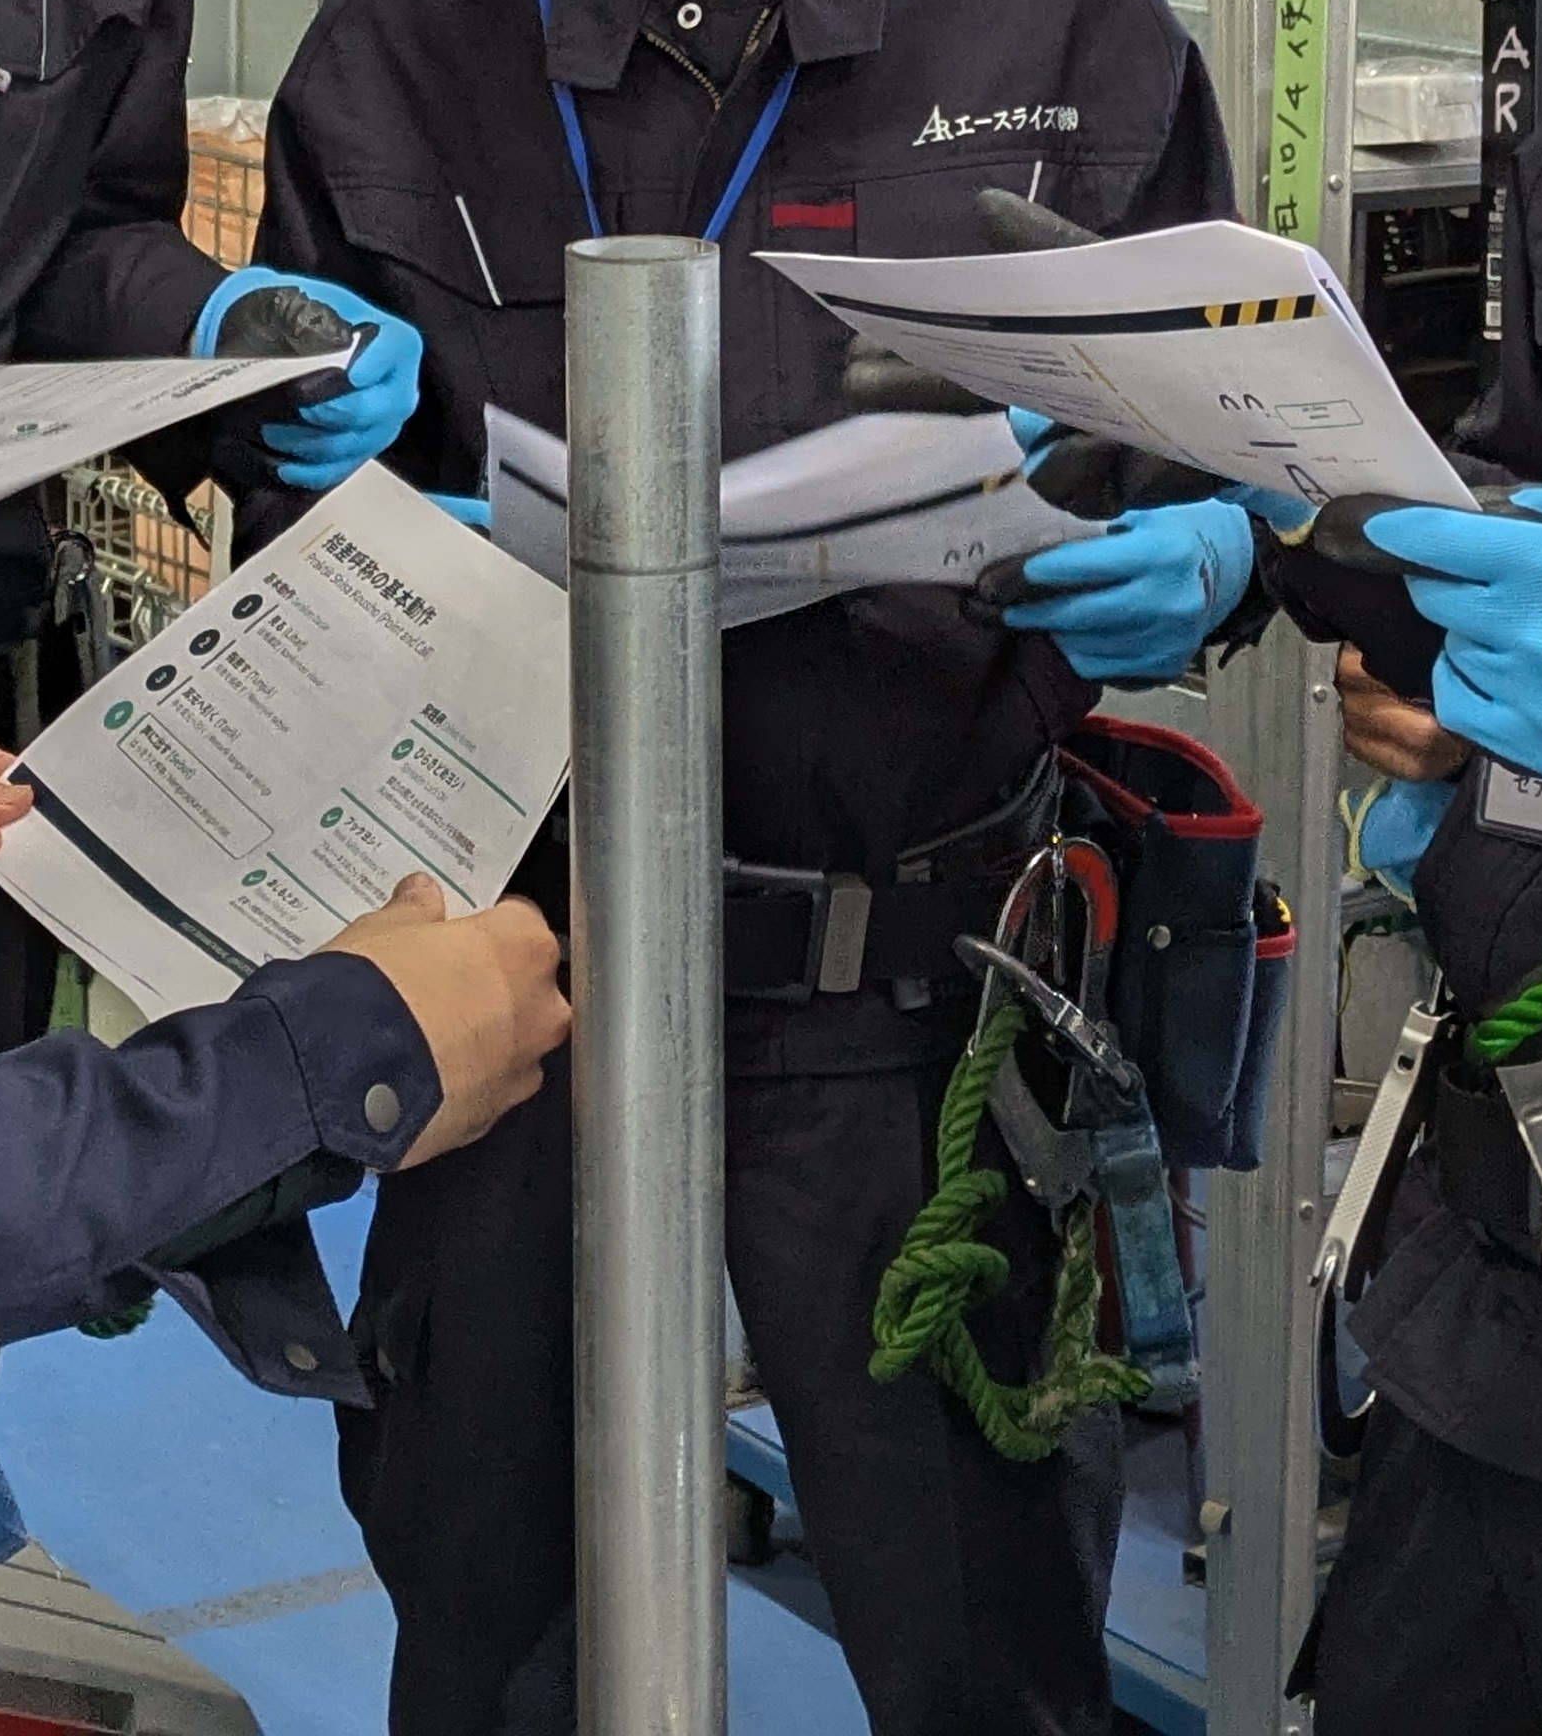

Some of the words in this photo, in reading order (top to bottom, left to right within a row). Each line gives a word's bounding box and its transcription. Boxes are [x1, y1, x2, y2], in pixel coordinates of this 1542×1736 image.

[1491, 25, 1531, 134] AR
[321, 527, 438, 631] 指差呼称の基本動作
